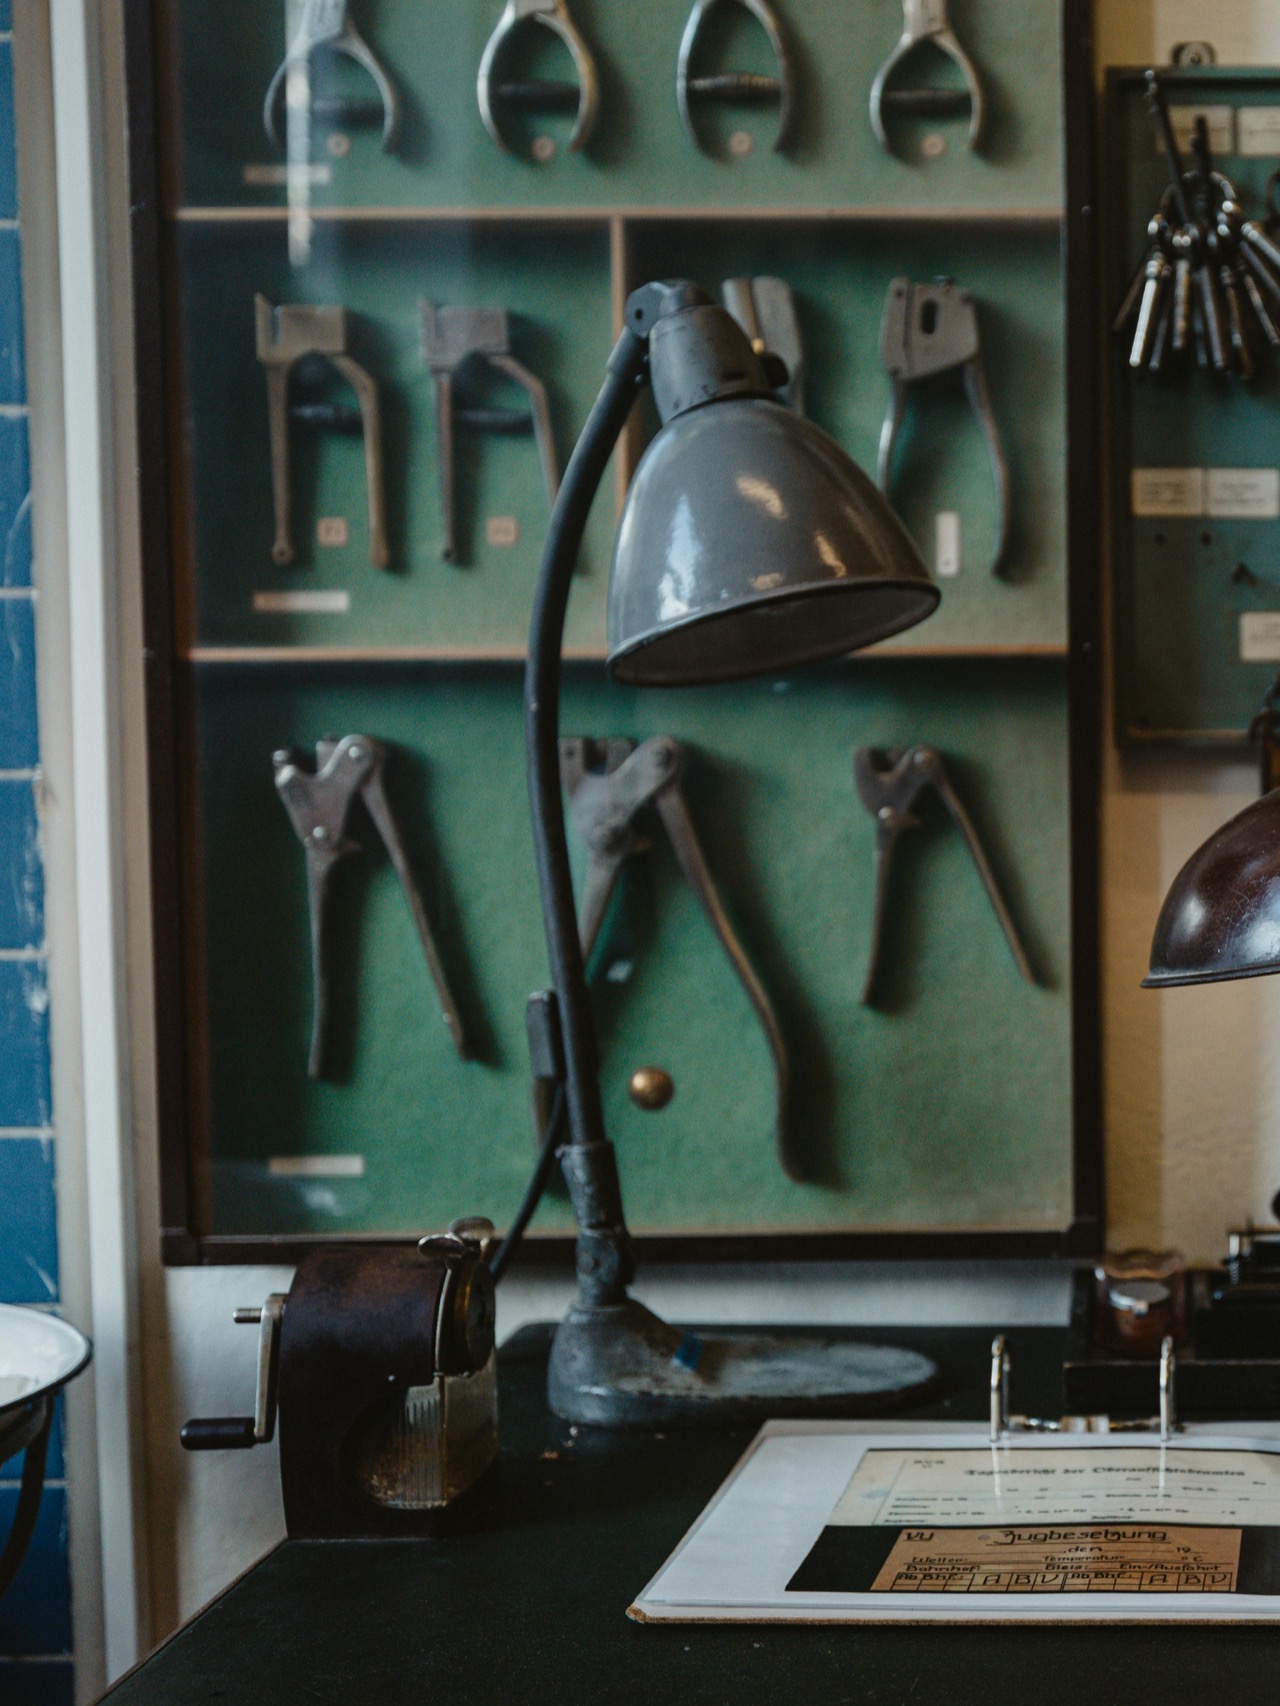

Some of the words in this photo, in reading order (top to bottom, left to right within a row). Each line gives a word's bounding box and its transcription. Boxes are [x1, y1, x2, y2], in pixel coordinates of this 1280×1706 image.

[993, 1528, 1168, 1545] Zugbesetzung
[1044, 1563, 1089, 1572] Gleis:
[1119, 1562, 1222, 1572] Ein-/Ausfahrt
[898, 1573, 918, 1581] Ab
[982, 1573, 1001, 1586] A
[1013, 1573, 1032, 1585] B
[1070, 1572, 1090, 1580] Ab
[1148, 1573, 1169, 1585] A
[1183, 1574, 1201, 1584] B
